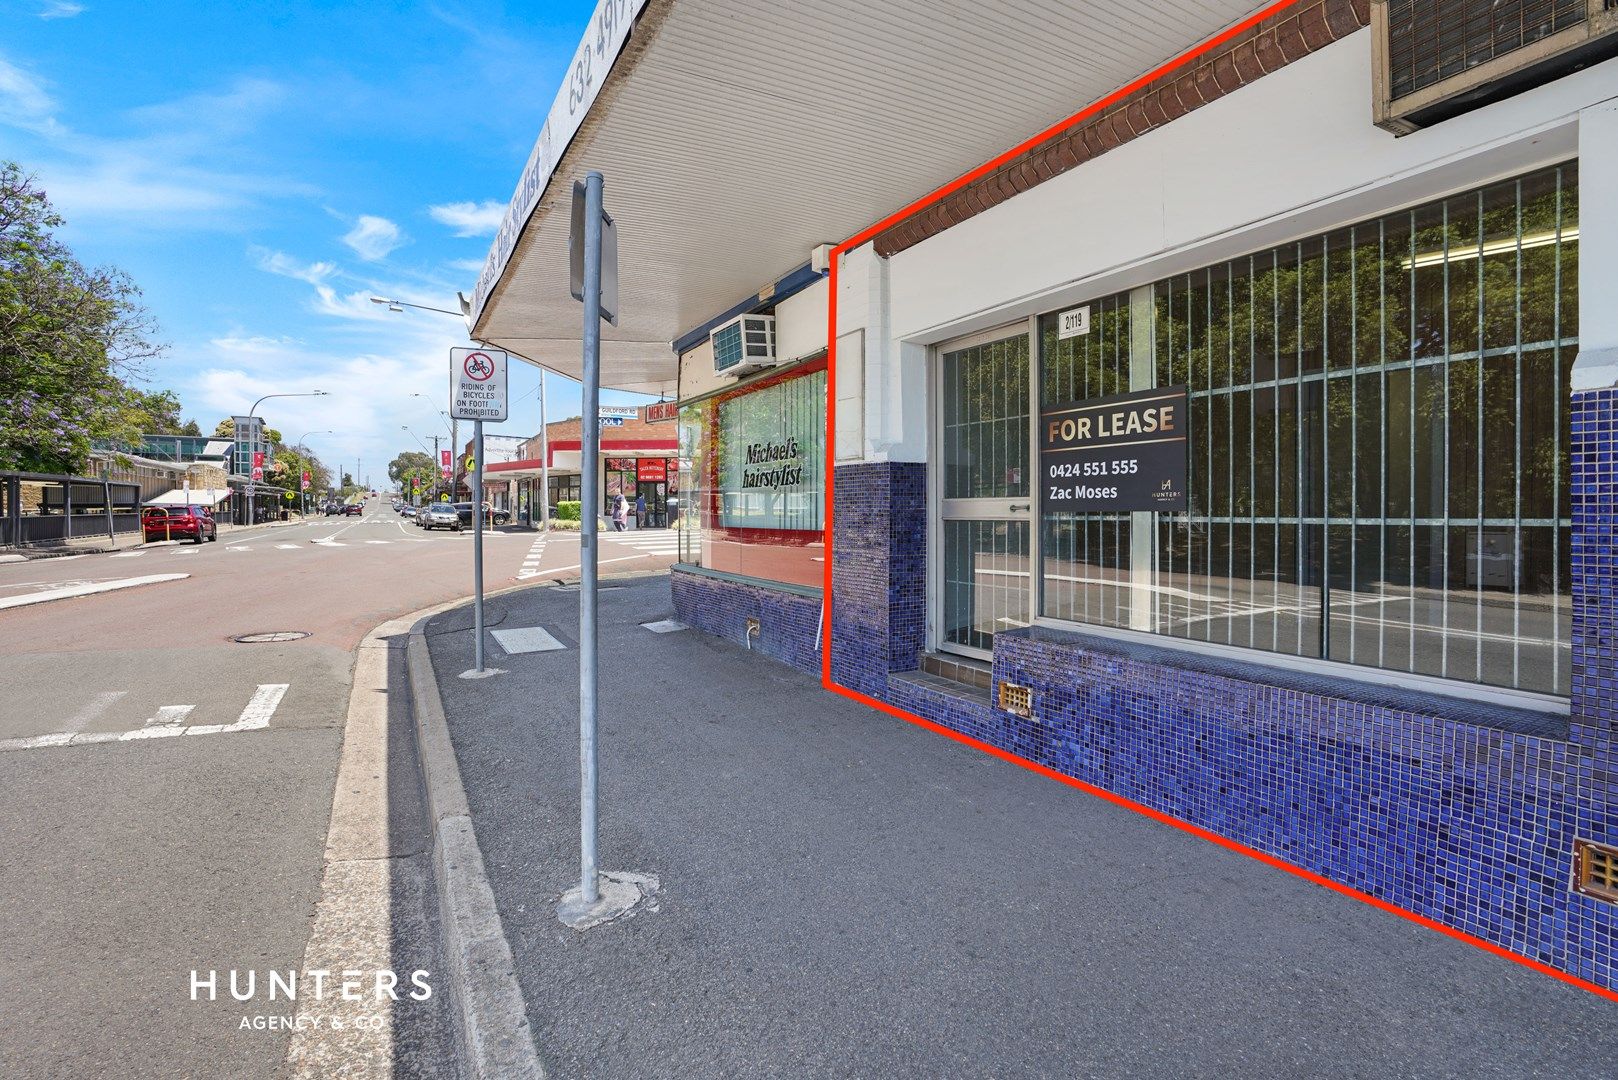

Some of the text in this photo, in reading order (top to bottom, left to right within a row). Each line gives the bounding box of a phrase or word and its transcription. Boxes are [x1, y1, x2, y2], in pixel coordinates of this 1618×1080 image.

[1065, 312, 1082, 331] 2/119
[461, 382, 496, 392] RIDING OF
[463, 391, 495, 399] BICYCLES
[456, 399, 467, 407] ON
[459, 408, 500, 416] PROHIBITED
[1048, 405, 1175, 443] FOR LEASE
[745, 436, 798, 465] Michael's
[742, 463, 802, 490] hairstylist
[1049, 459, 1138, 478] 0424 551 555
[1049, 485, 1118, 500] Zac Moses
